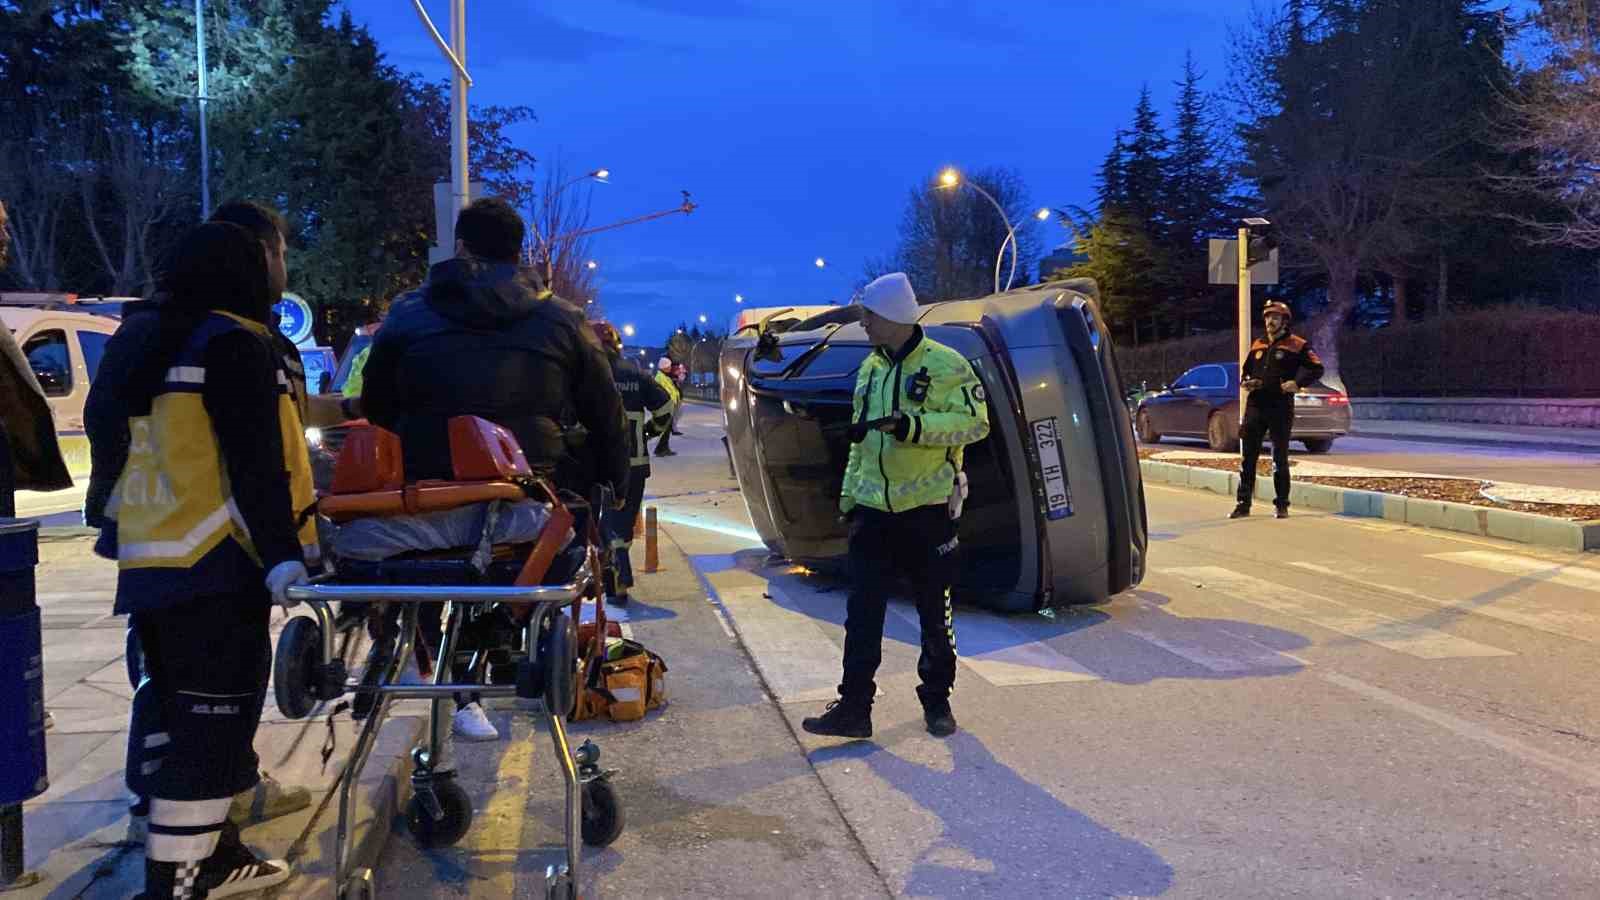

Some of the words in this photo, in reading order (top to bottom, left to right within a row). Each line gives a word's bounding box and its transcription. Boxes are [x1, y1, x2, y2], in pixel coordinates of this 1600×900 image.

[1036, 421, 1055, 449] 322
[1043, 465, 1061, 482] TH
[1049, 494, 1066, 509] 19
